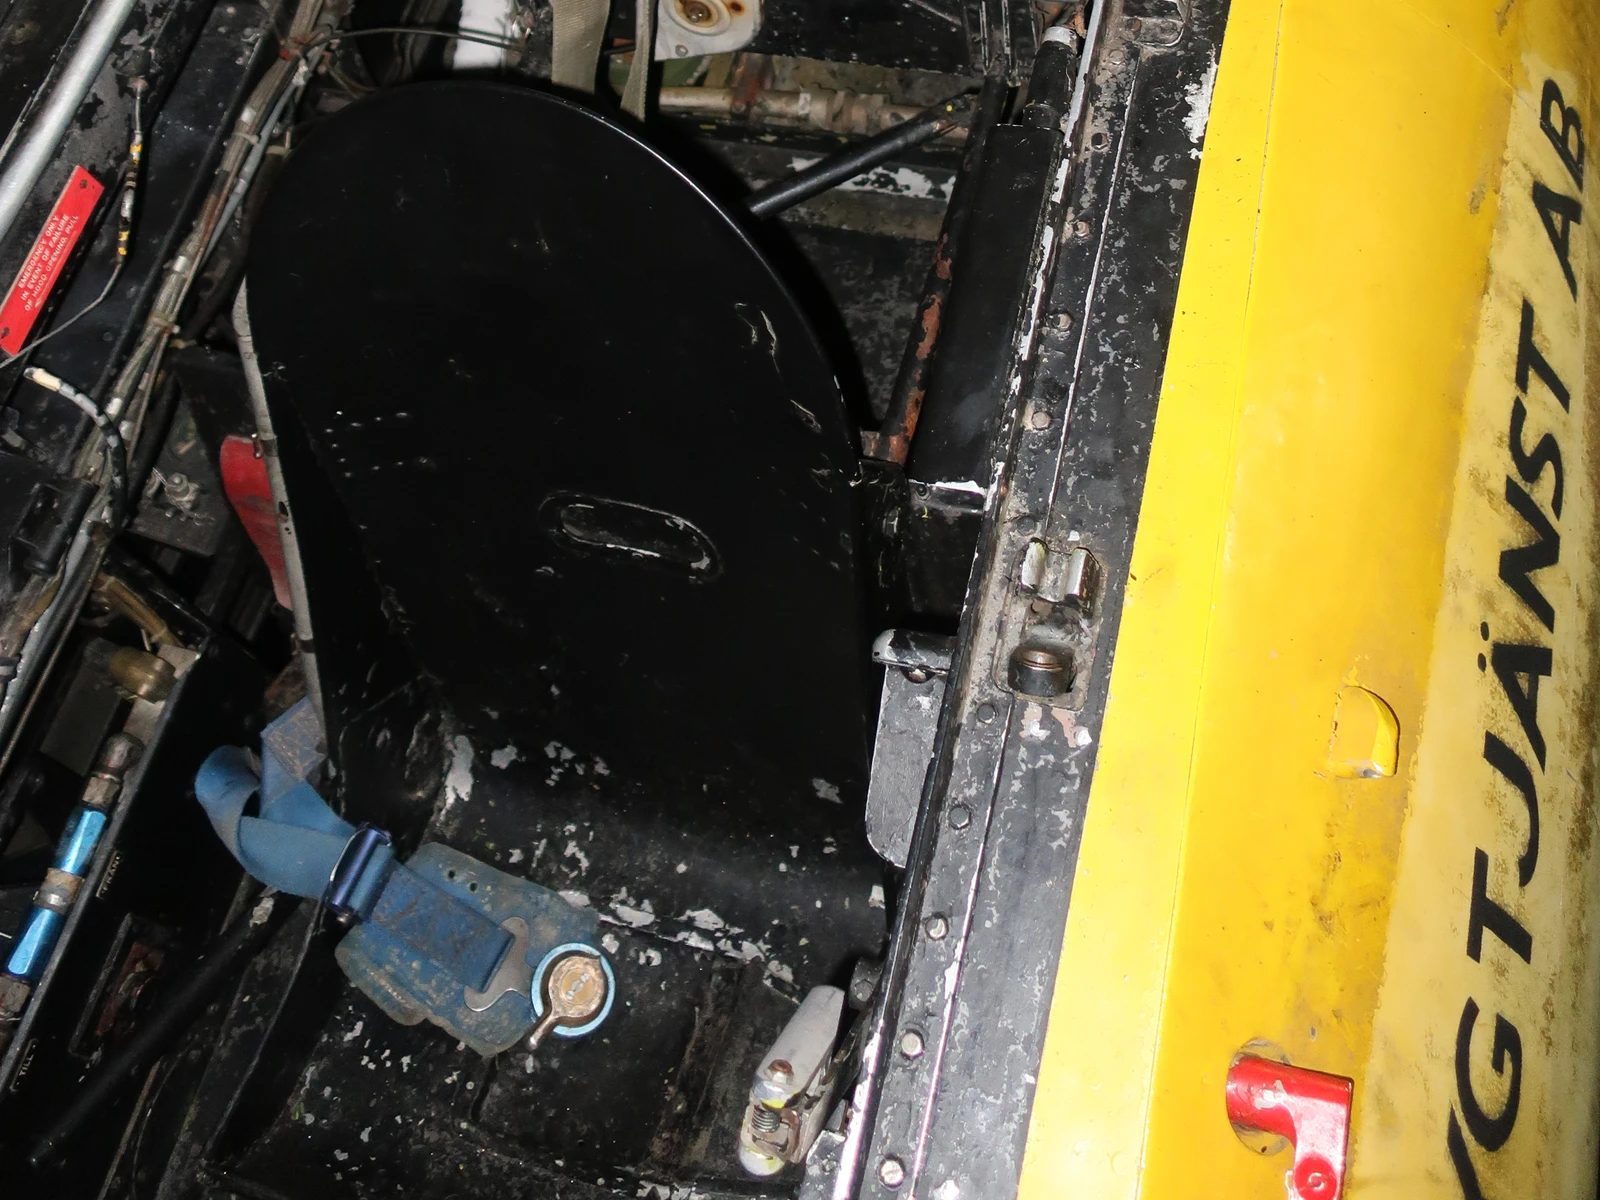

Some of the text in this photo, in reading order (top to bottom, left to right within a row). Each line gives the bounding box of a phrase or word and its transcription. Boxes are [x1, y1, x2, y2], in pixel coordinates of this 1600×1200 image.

[1531, 78, 1585, 304] AB
[18, 215, 60, 289] EMERGENCY ONLY
[20, 213, 70, 301] IN EVENT OF FAILURE
[24, 299, 34, 312] OF
[31, 273, 47, 298] HOOD
[64, 215, 79, 235] PULL
